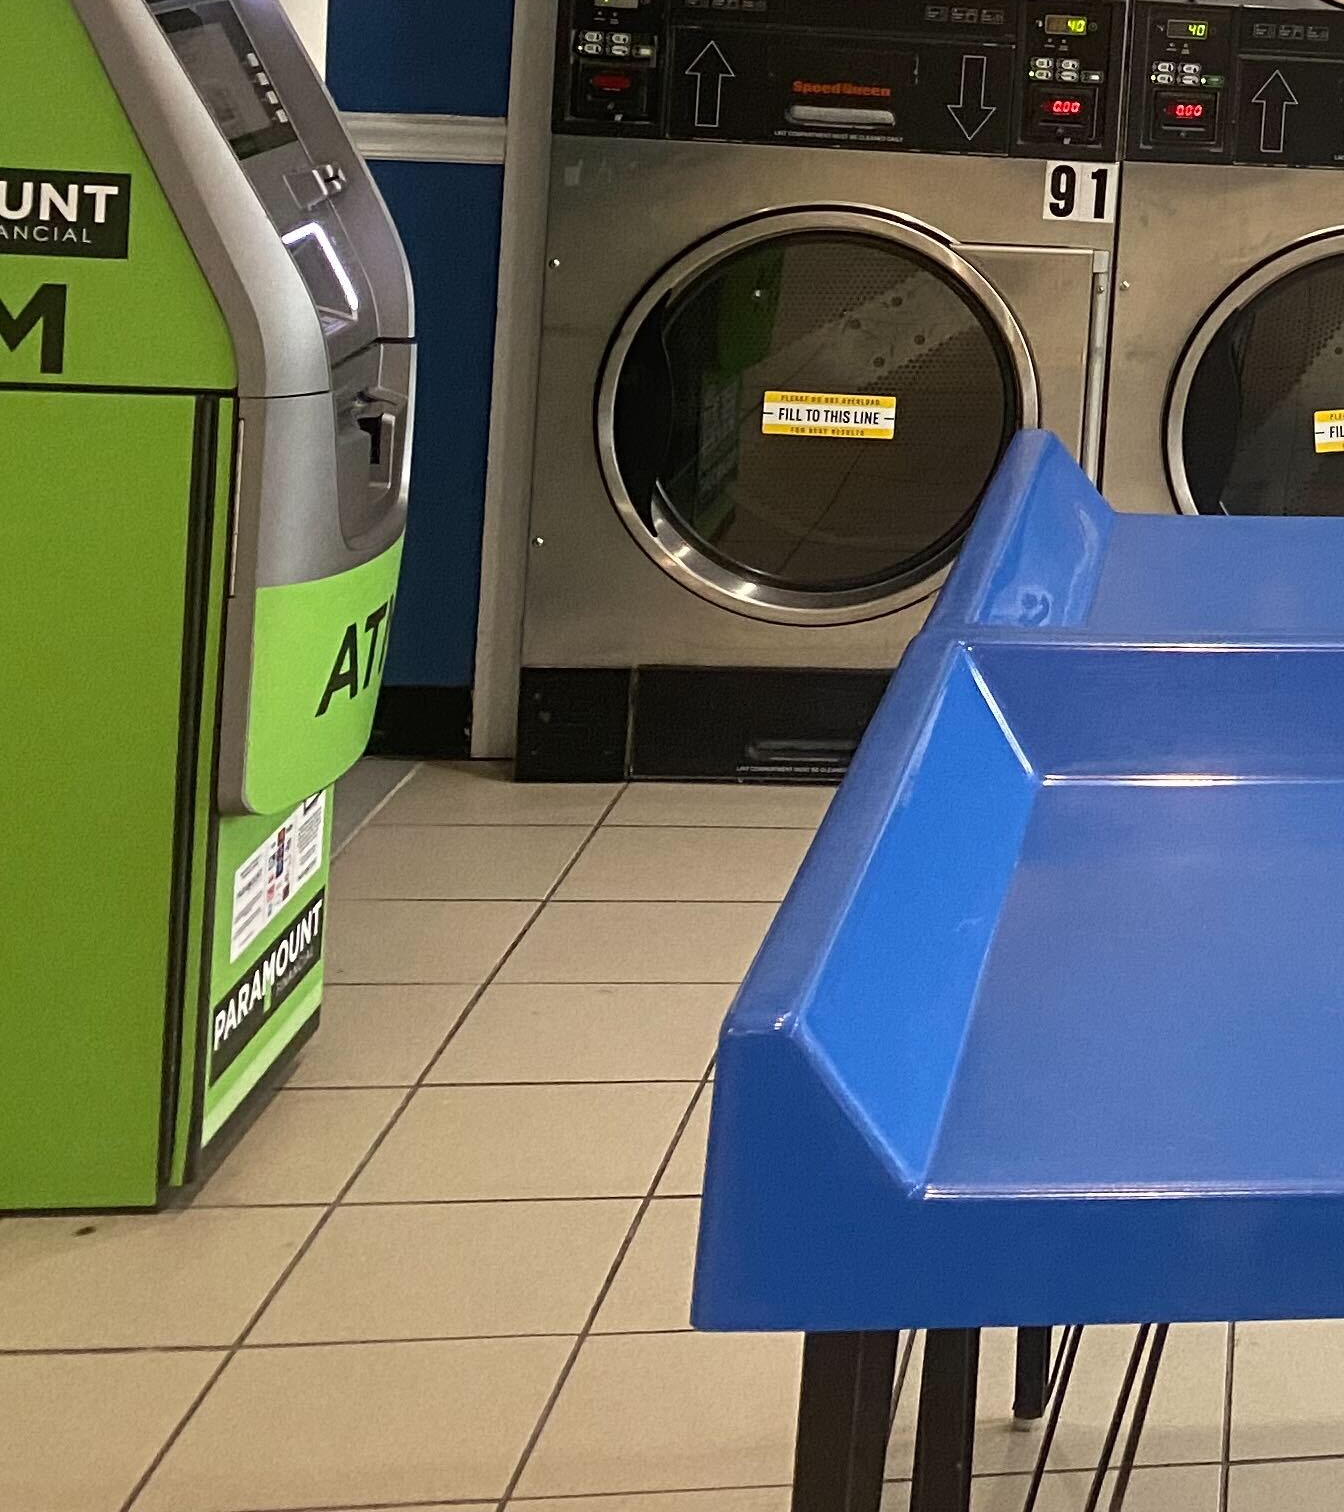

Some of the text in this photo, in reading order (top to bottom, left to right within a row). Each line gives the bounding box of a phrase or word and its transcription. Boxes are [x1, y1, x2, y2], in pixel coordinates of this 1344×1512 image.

[1067, 18, 1086, 33] 40
[1188, 24, 1206, 37] 40
[1048, 164, 1108, 219] 91
[778, 407, 879, 425] FILL TO THIS LINE
[214, 899, 323, 1051] PARAMOUNT
